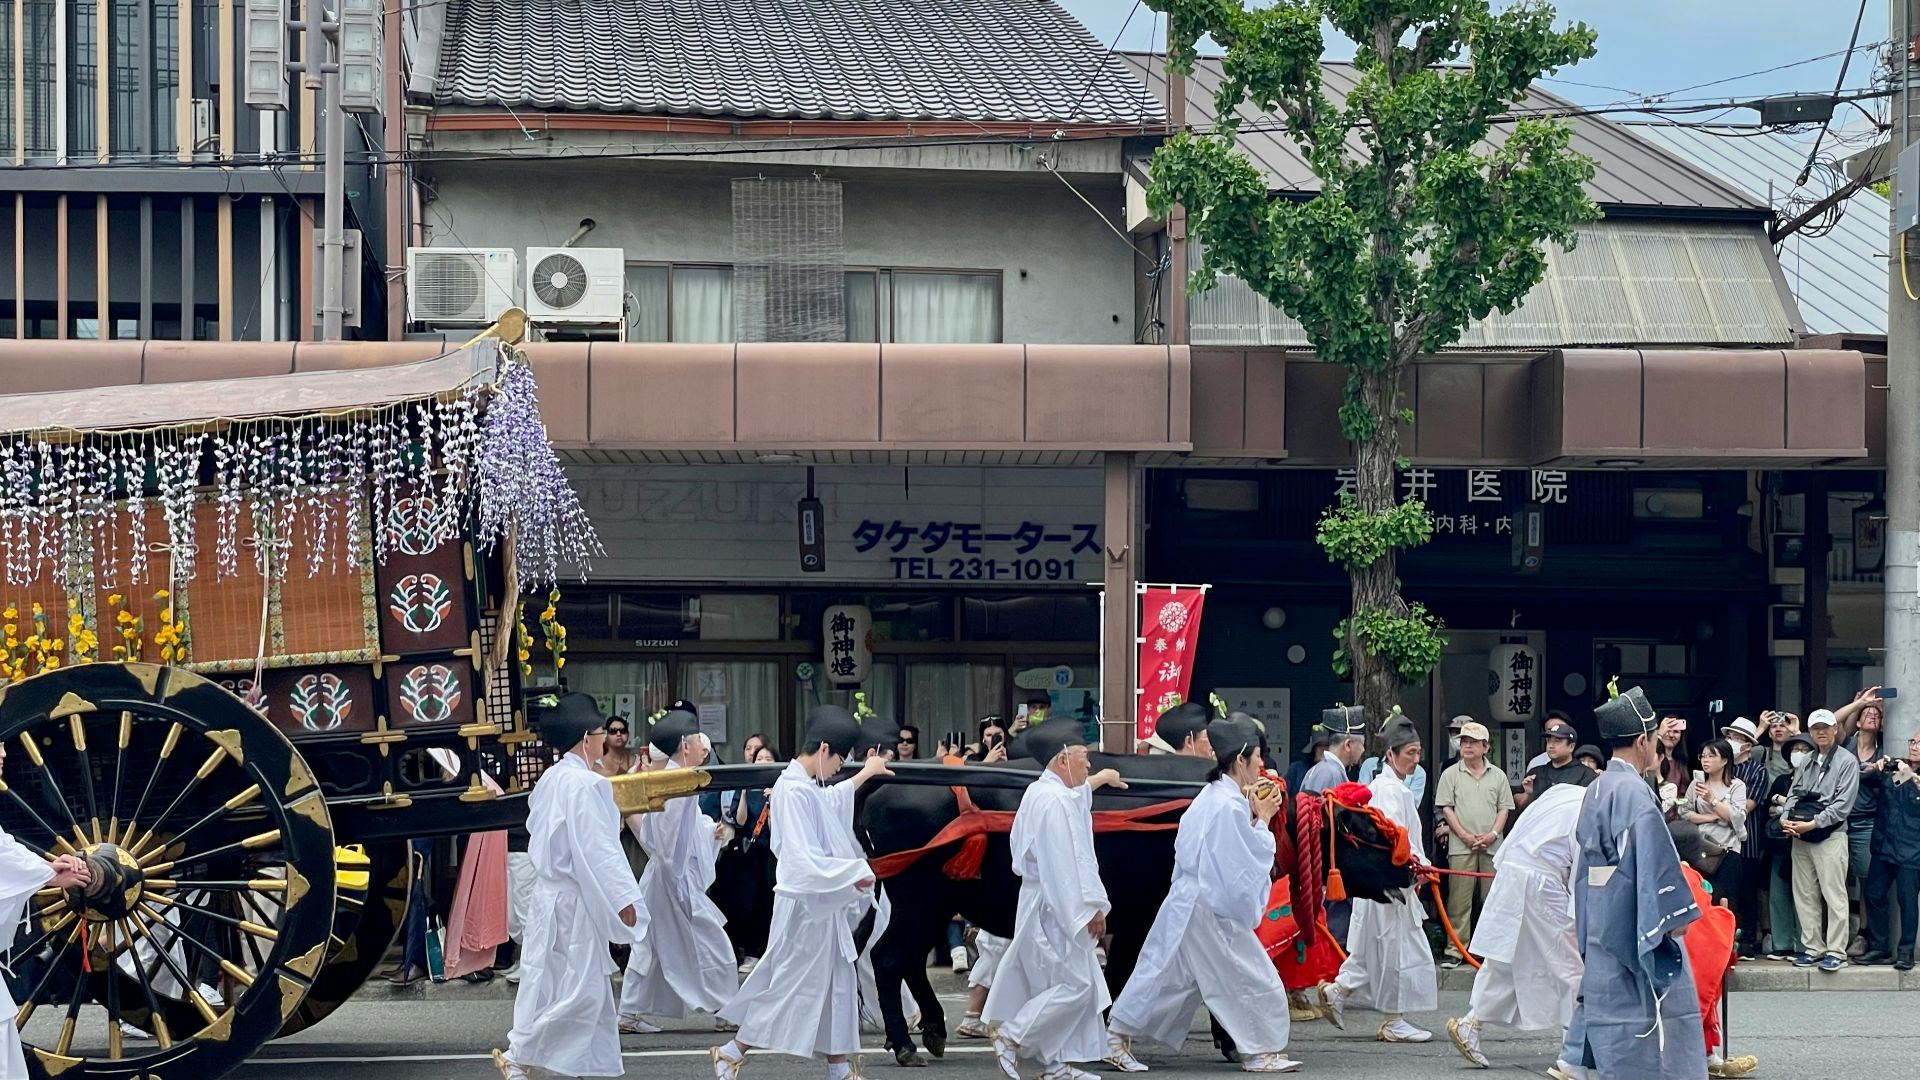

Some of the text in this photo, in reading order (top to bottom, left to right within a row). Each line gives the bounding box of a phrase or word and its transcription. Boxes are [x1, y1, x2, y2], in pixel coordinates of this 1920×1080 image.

[574, 479, 837, 523] UZUKI
[853, 520, 1102, 554] タケダモータース
[890, 557, 1075, 580] TEL 231-1091
[635, 639, 679, 647] SUZUKI
[831, 612, 857, 676] 御神燈
